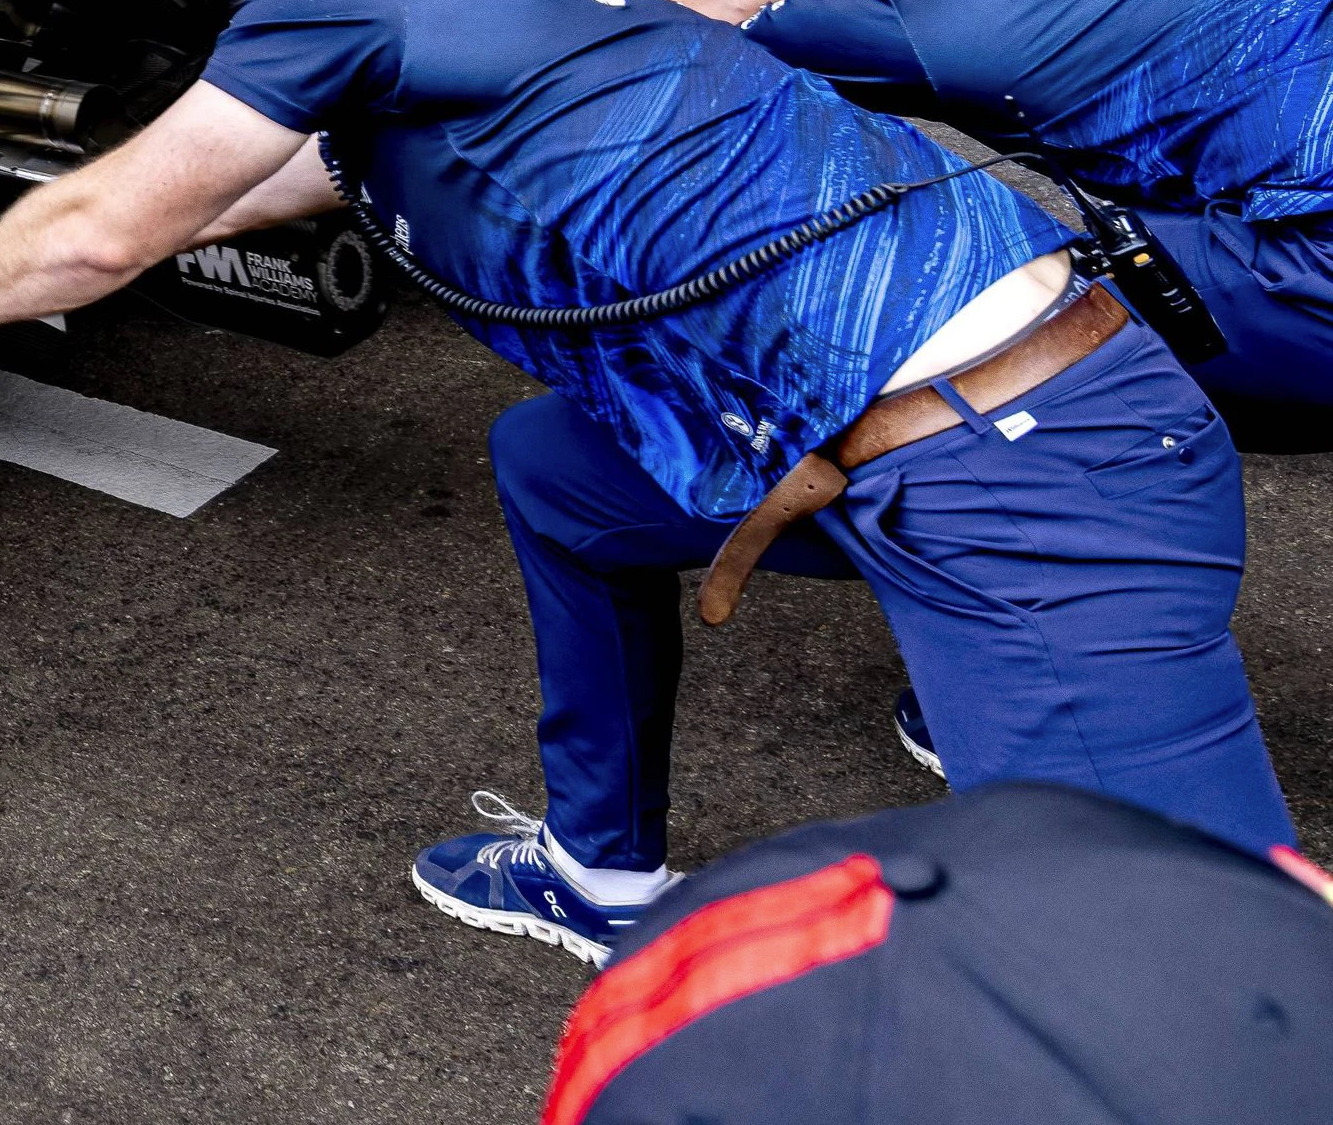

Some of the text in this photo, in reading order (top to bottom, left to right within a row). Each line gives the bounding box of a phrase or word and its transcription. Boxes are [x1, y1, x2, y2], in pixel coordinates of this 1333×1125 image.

[246, 251, 292, 273] FRANK
[248, 266, 314, 291] WILLIAMS
[251, 279, 319, 303] ACADEMY
